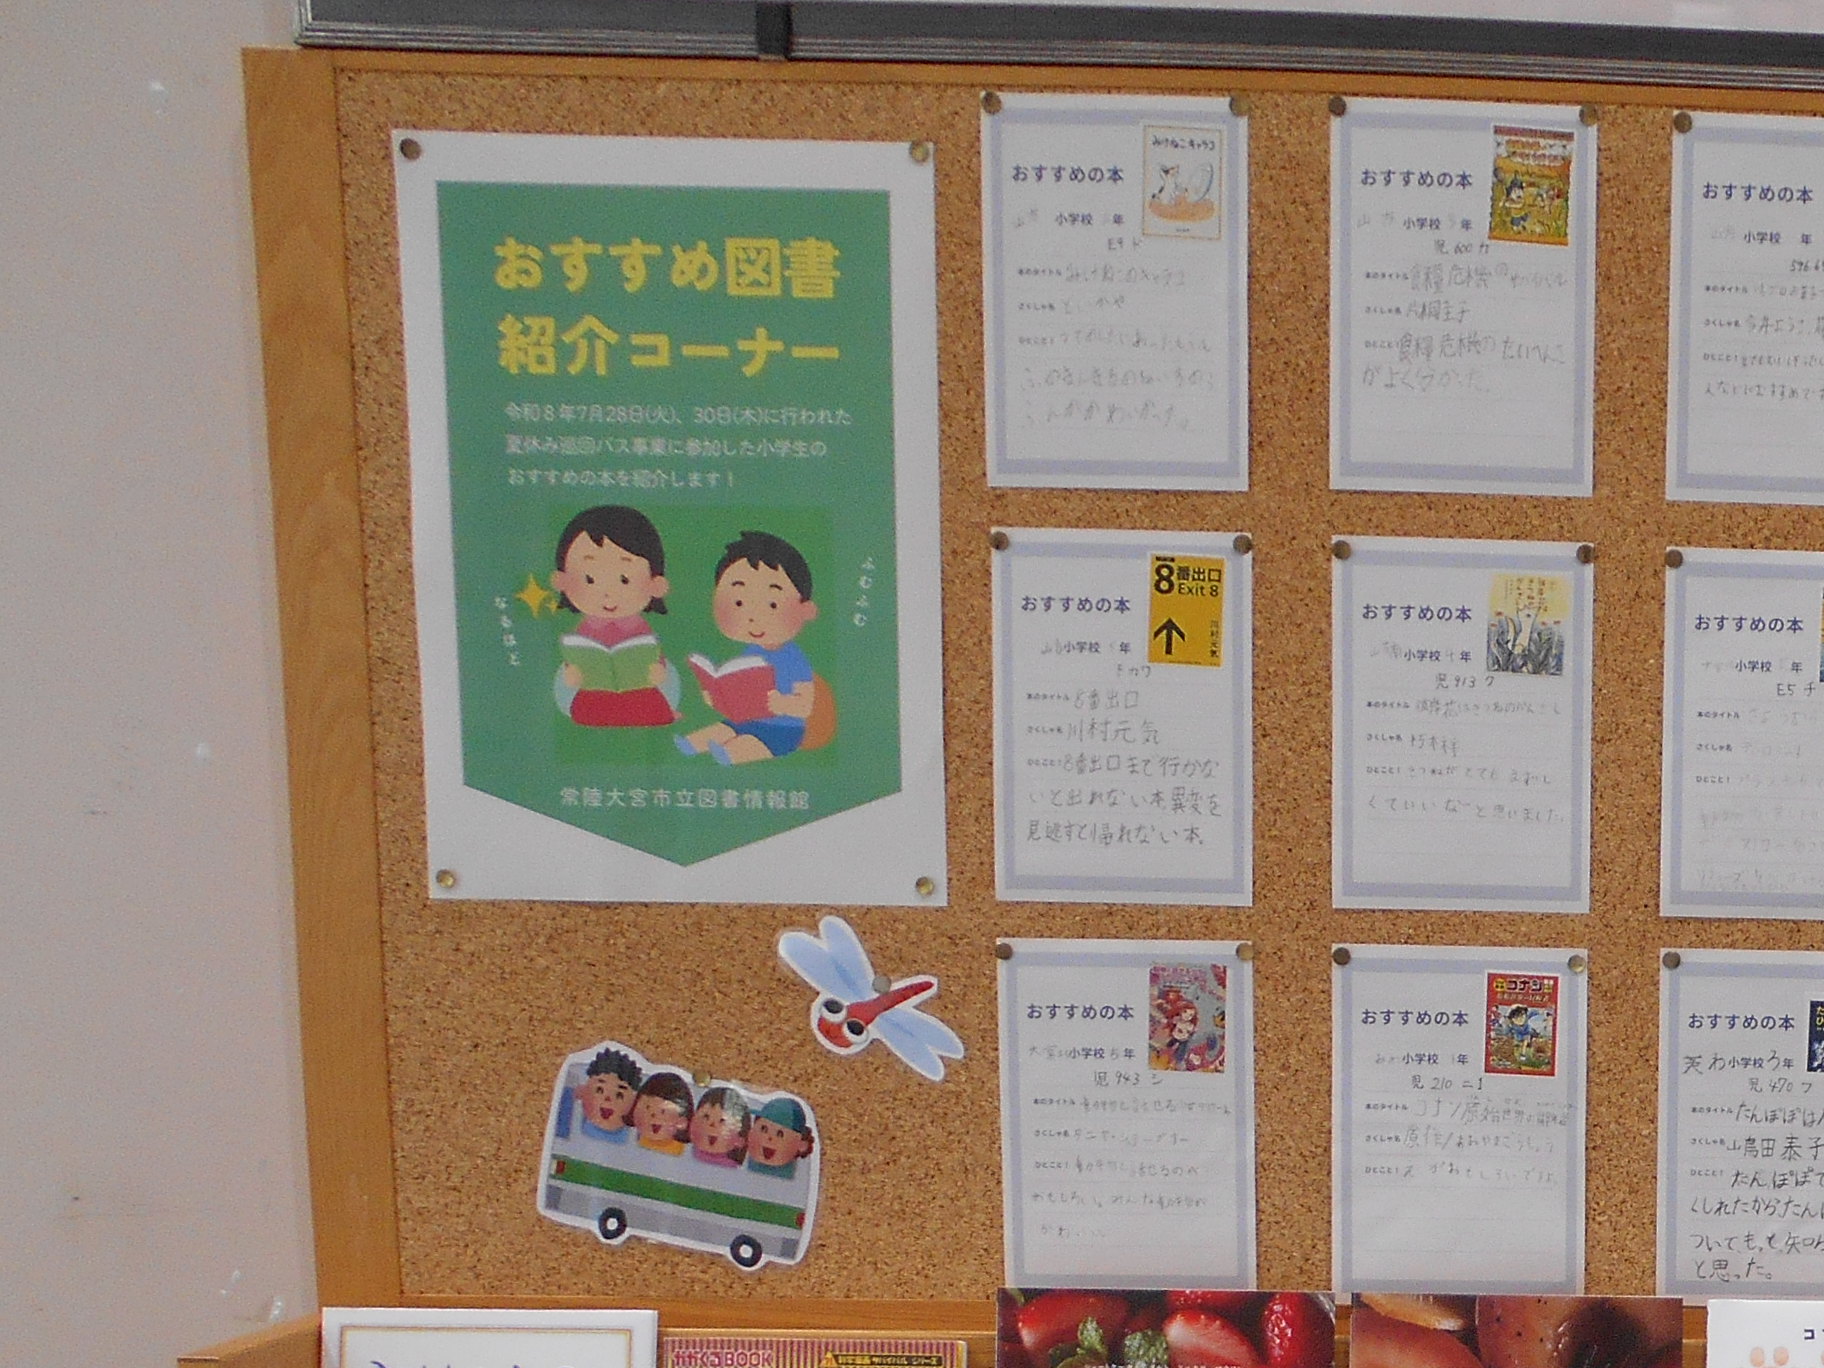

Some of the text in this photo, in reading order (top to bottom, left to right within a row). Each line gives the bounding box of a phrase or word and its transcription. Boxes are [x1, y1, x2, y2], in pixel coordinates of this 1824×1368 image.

[1012, 164, 1124, 185] おすすめの本
[1360, 168, 1473, 189] おすすめの本
[1701, 181, 1814, 204] おすすめの本
[493, 236, 841, 298] おすすめ図書
[498, 313, 840, 376] 紹介コーナー
[506, 436, 827, 458] 夏休み巡回バス事業に参加した小学生の
[508, 468, 735, 489] おすすめの本を紹介します！
[1154, 561, 1223, 595] 8 番出口
[1176, 582, 1220, 598] Exit 8
[1021, 595, 1131, 614] おすすめの本
[1361, 603, 1473, 624] おすすめの本
[1694, 614, 1804, 634] おすすめの本
[1404, 650, 1440, 662] 小学校
[1067, 718, 1159, 745] 川村元気
[560, 787, 810, 811] 常陸大宮市立図書情報館
[1026, 1003, 1135, 1022] おすすめの本
[1361, 1008, 1469, 1028] おすすめの本
[1688, 1013, 1795, 1032] おすすめの本
[1728, 1057, 1765, 1068] 小学校
[1769, 1078, 1793, 1093] 470
[1695, 1257, 1773, 1282] と思った。
